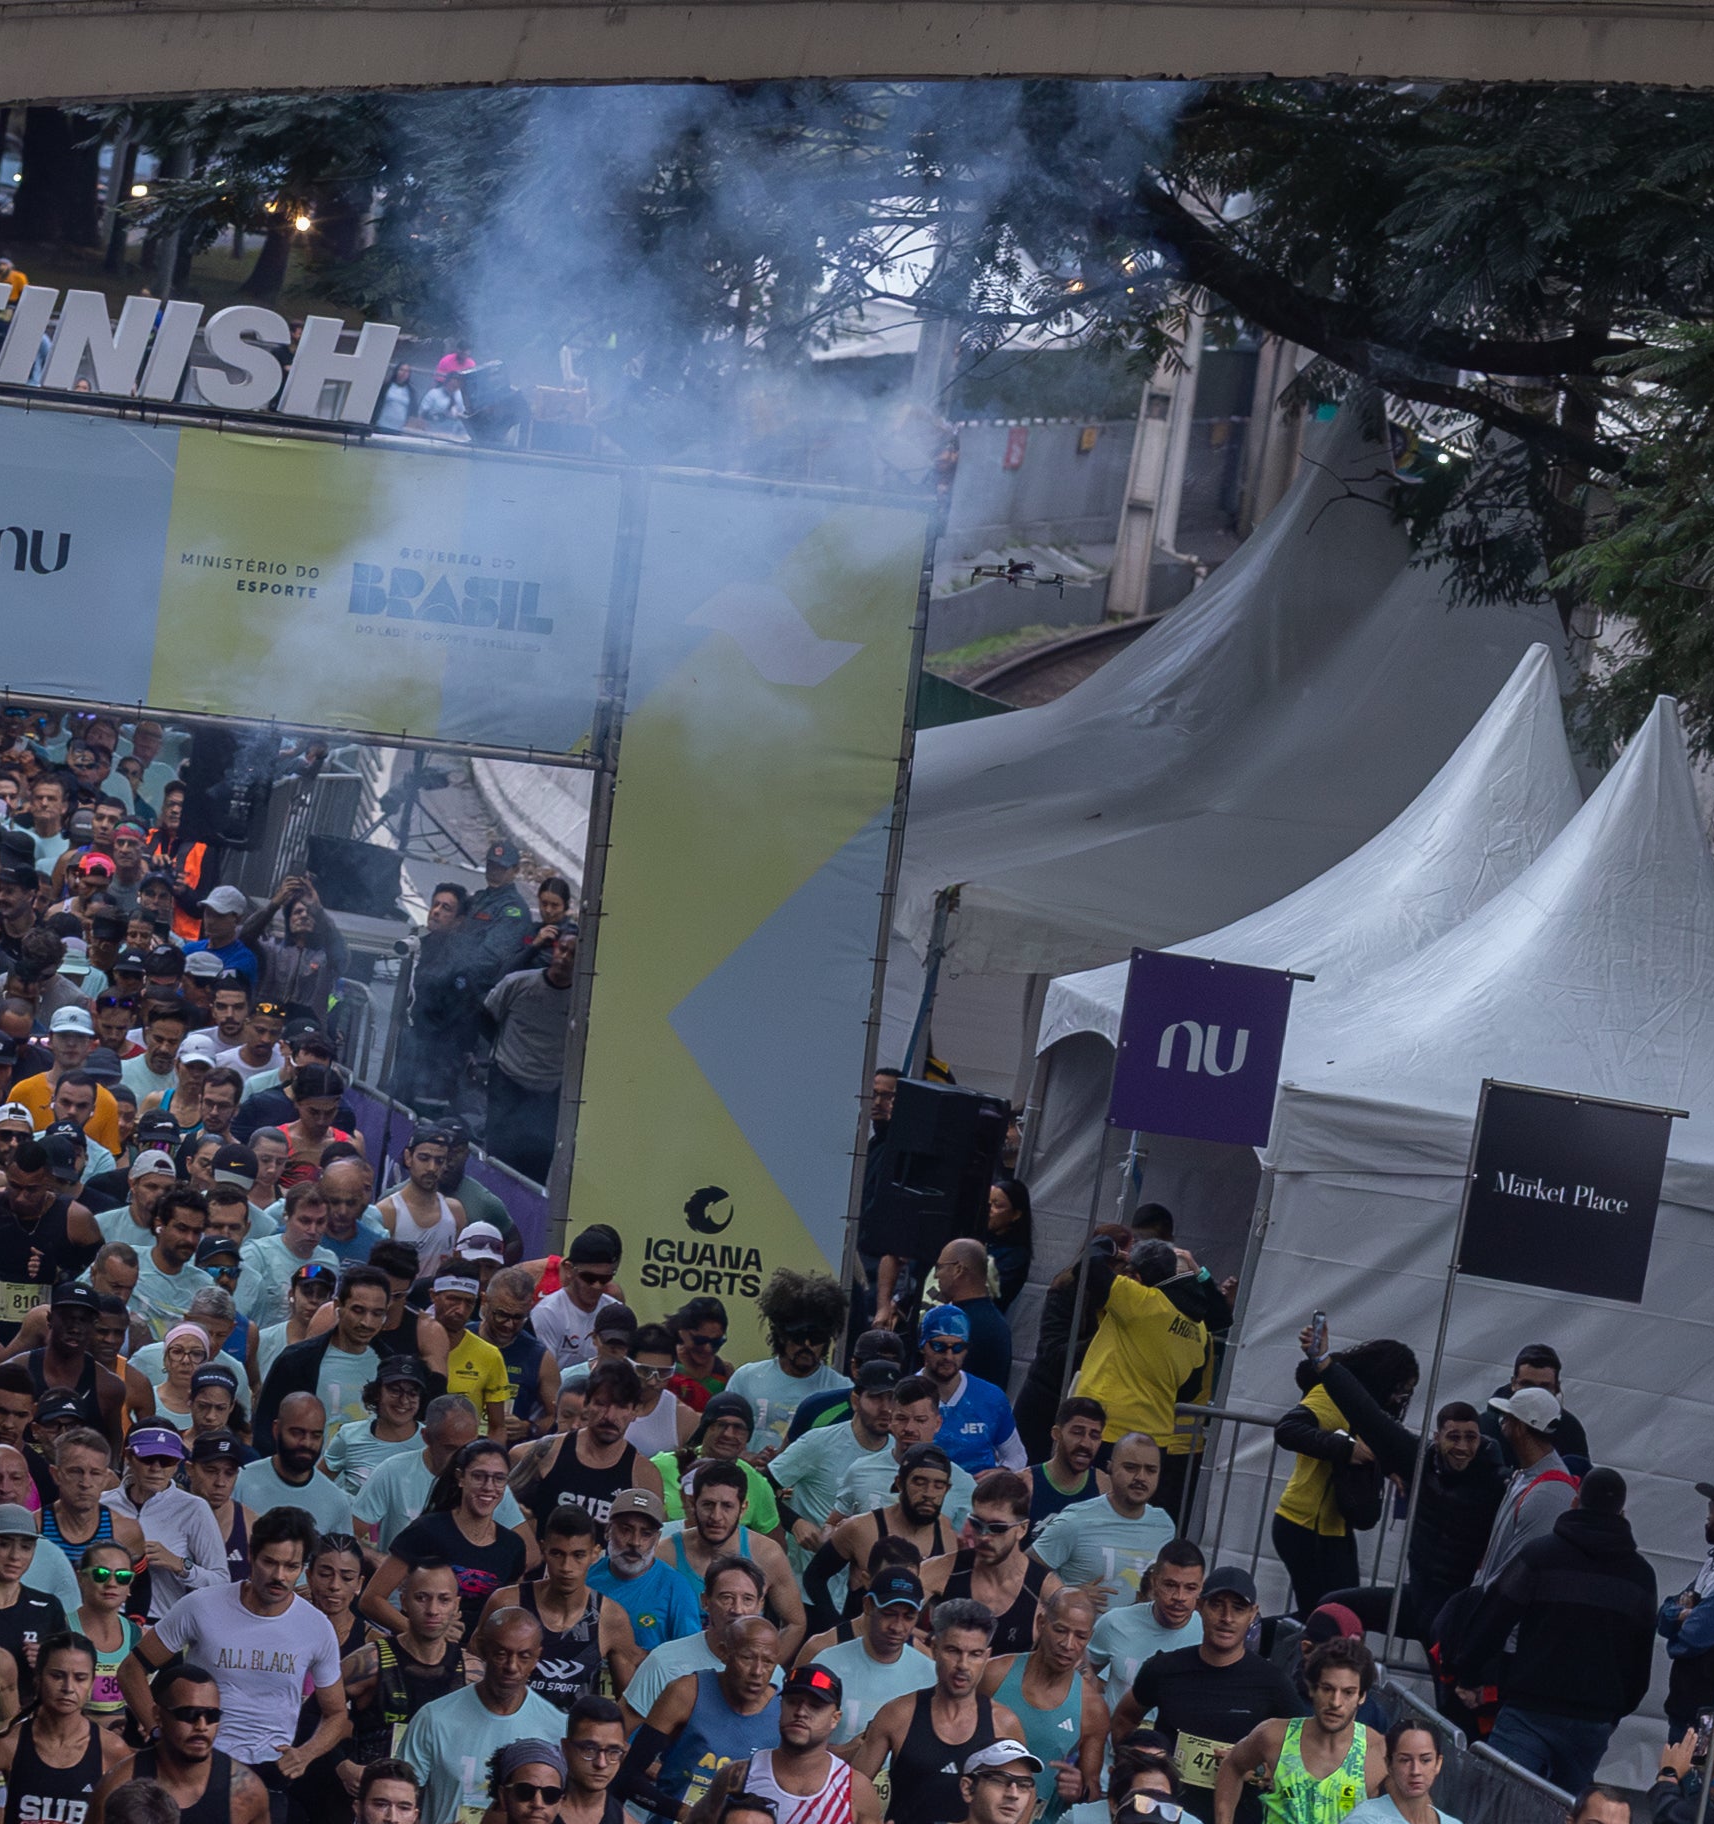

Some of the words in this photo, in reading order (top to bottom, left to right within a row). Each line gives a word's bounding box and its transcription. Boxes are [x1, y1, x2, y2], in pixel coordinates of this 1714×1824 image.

[181, 553, 287, 576] MINISTÉRIO
[295, 564, 320, 579] DO
[237, 579, 318, 599] ESPORTE
[348, 562, 554, 636] BRASIL
[1156, 1019, 1250, 1077] nu
[1492, 1171, 1567, 1204] Market
[1572, 1184, 1629, 1215] Place
[644, 1238, 763, 1272] IGUANA
[640, 1264, 761, 1298] SPORTS
[13, 1294, 40, 1309] 810
[959, 1423, 986, 1434] JET
[217, 1648, 249, 1670] ALL
[251, 1648, 297, 1675] BLACK
[545, 1682, 580, 1693] SPORT
